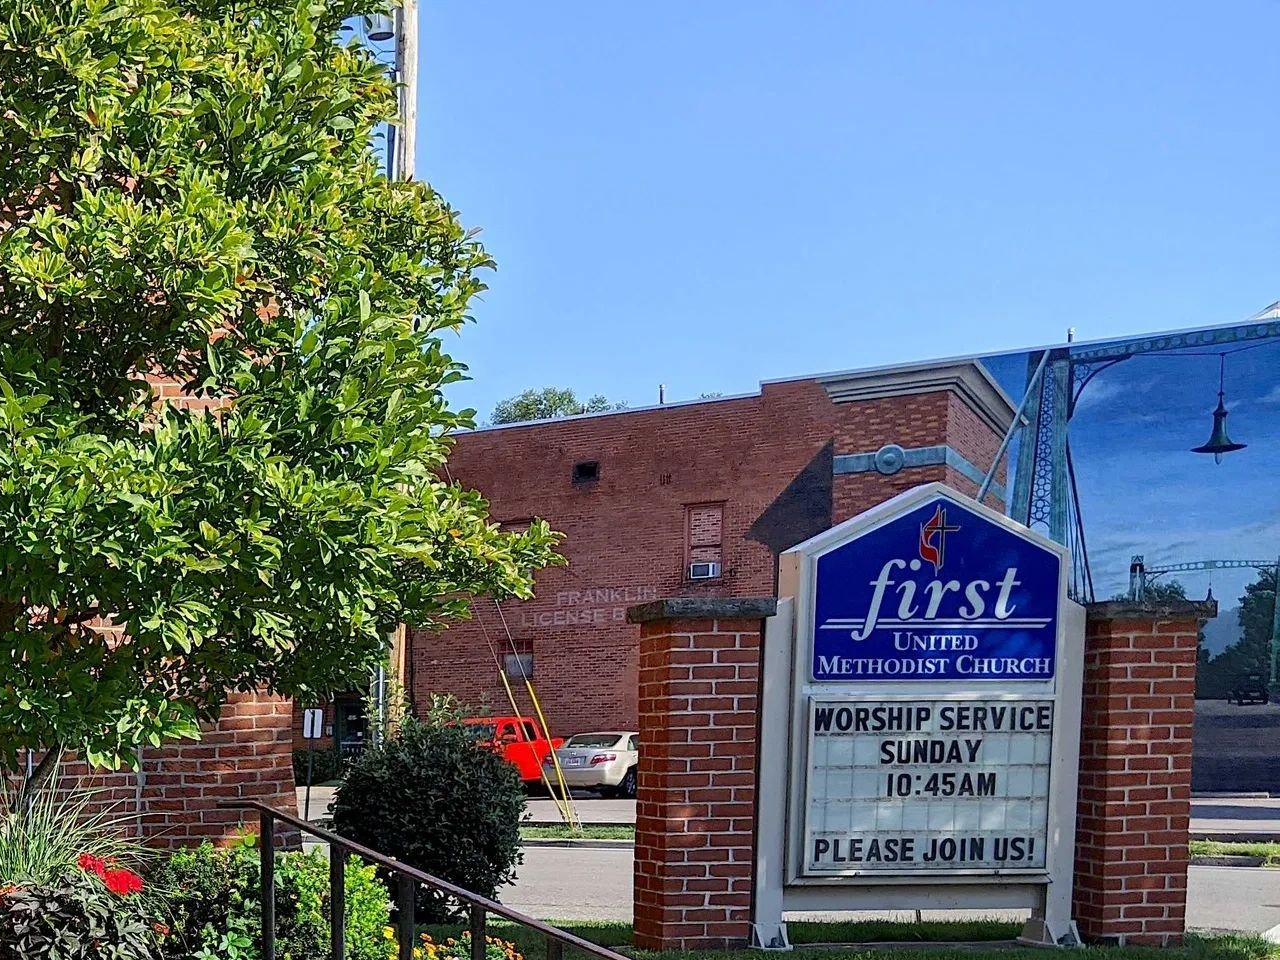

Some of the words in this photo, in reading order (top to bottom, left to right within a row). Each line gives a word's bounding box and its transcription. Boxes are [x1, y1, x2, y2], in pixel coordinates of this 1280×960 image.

[850, 558, 1022, 641] first
[521, 608, 605, 627] LICENSE
[893, 631, 979, 651] UNITED
[817, 655, 950, 675] METHODIST
[955, 654, 1051, 674] CHURCH
[814, 706, 932, 731] WORSHIP
[939, 705, 1051, 730] SERVICE
[880, 739, 983, 765] SUNDAY
[886, 772, 997, 797] 10:45AM
[814, 838, 915, 863] PLEASE
[922, 837, 985, 862] JOIN
[993, 836, 1036, 862] US!
